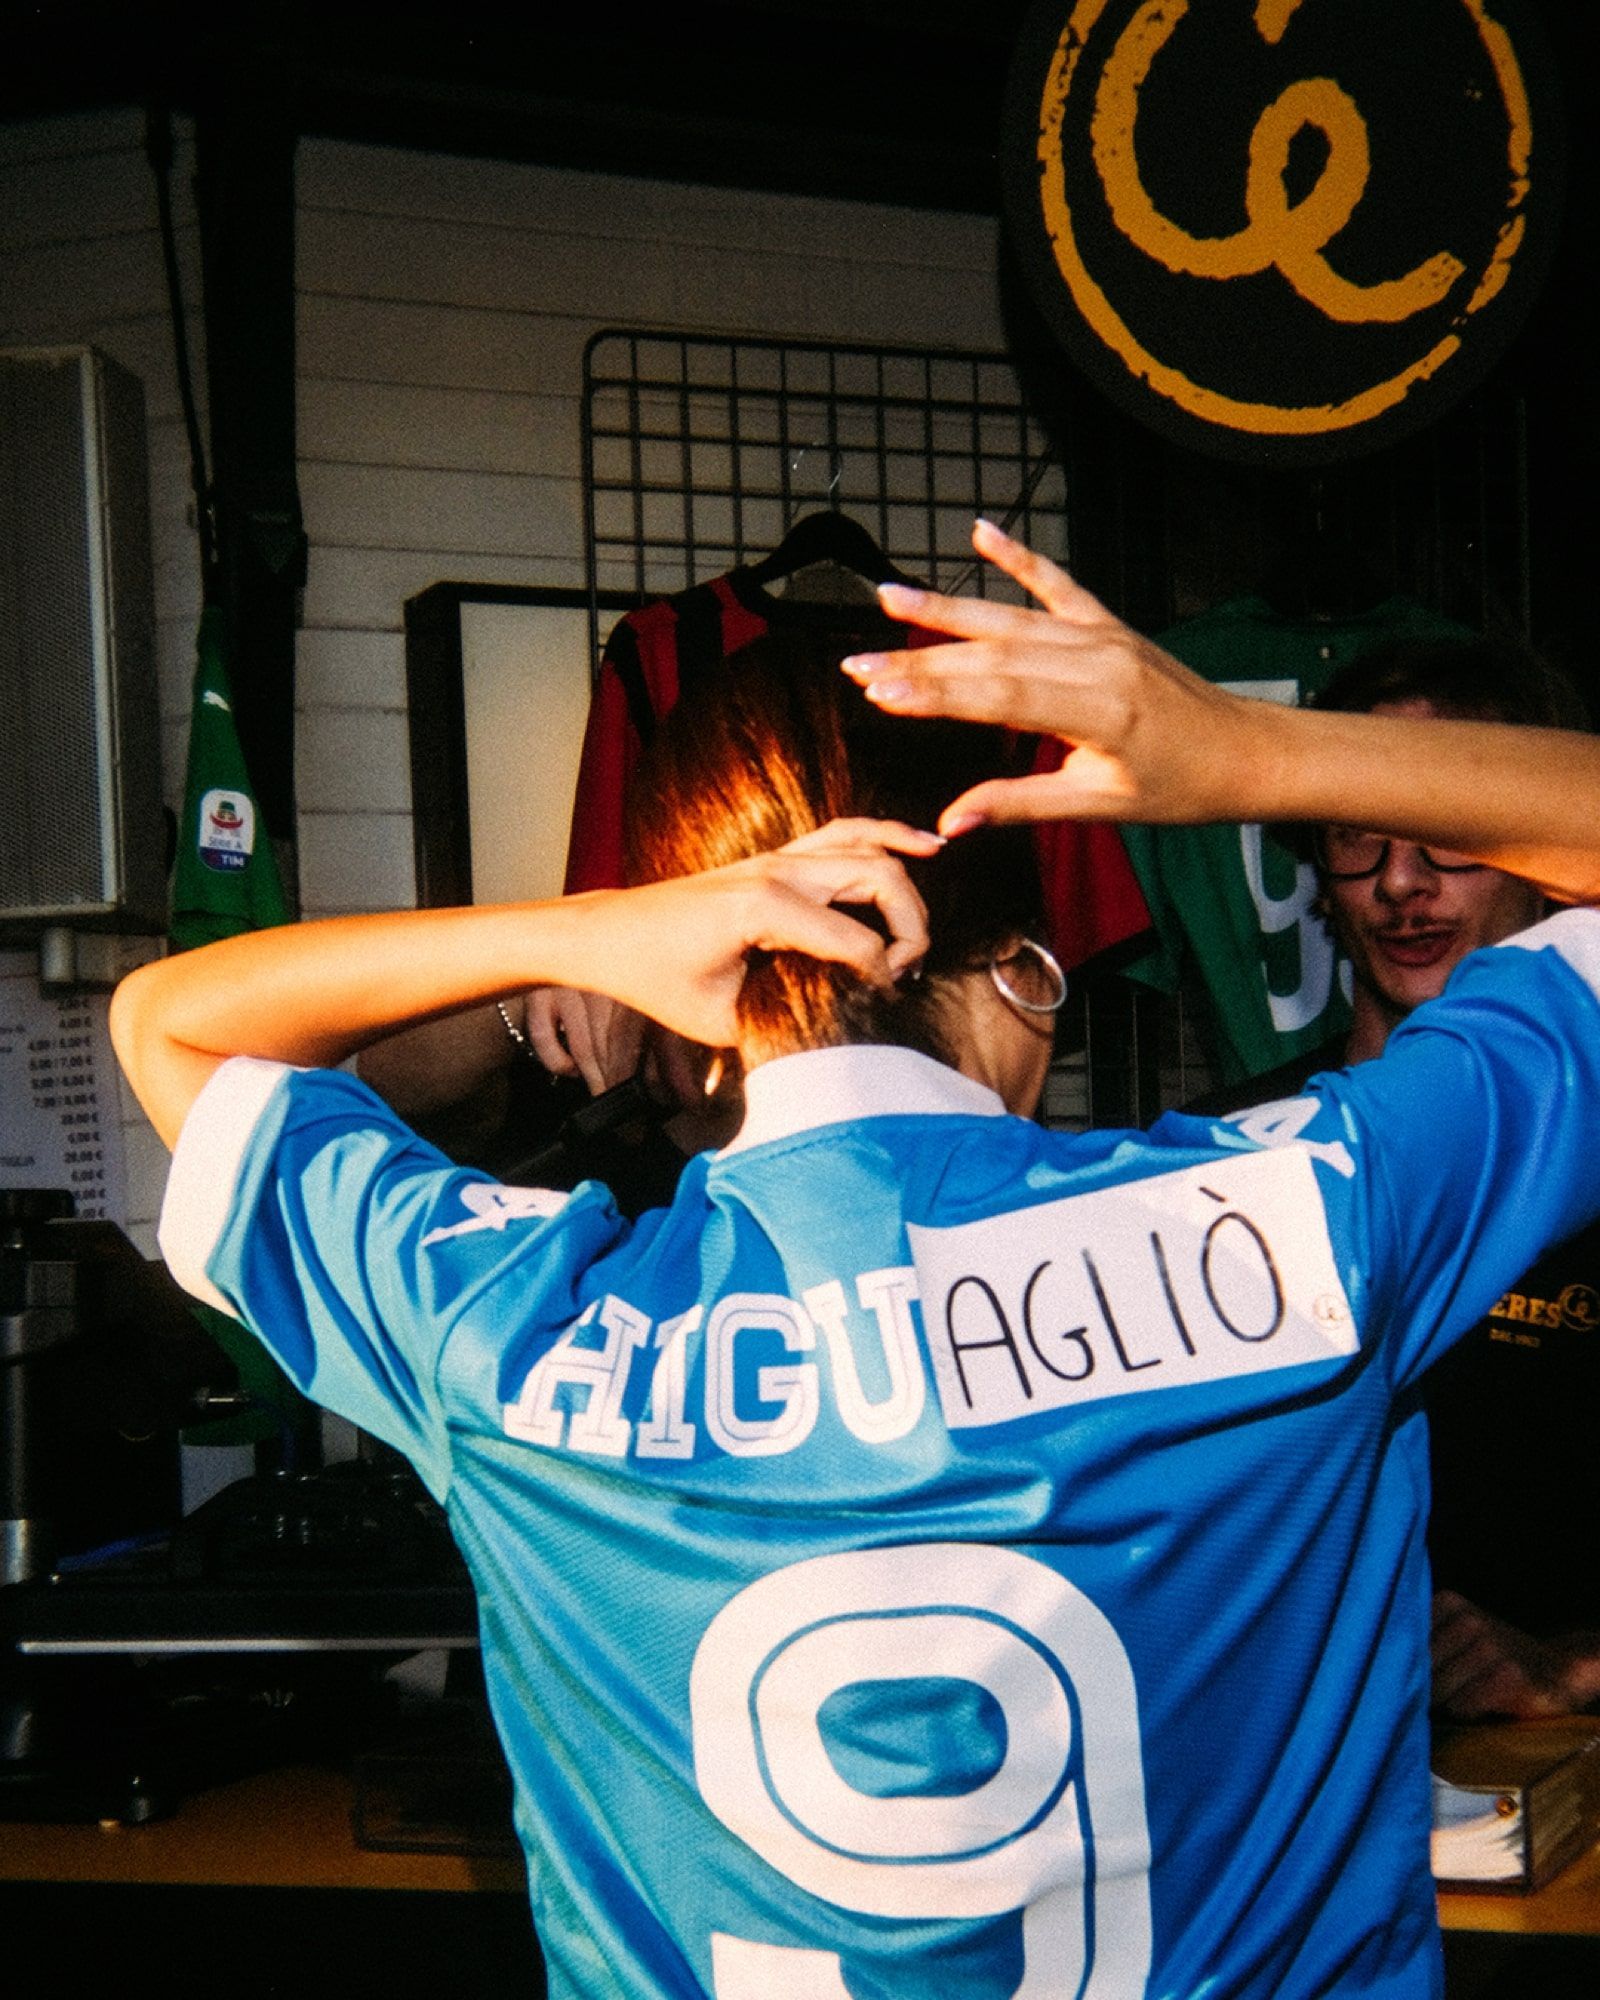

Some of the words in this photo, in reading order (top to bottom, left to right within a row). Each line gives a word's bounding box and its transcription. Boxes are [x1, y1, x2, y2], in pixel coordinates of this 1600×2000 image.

[503, 1267, 928, 1460] HIGU
[945, 1186, 1286, 1409] AGLIÒ
[689, 1542, 1153, 2000] 9
